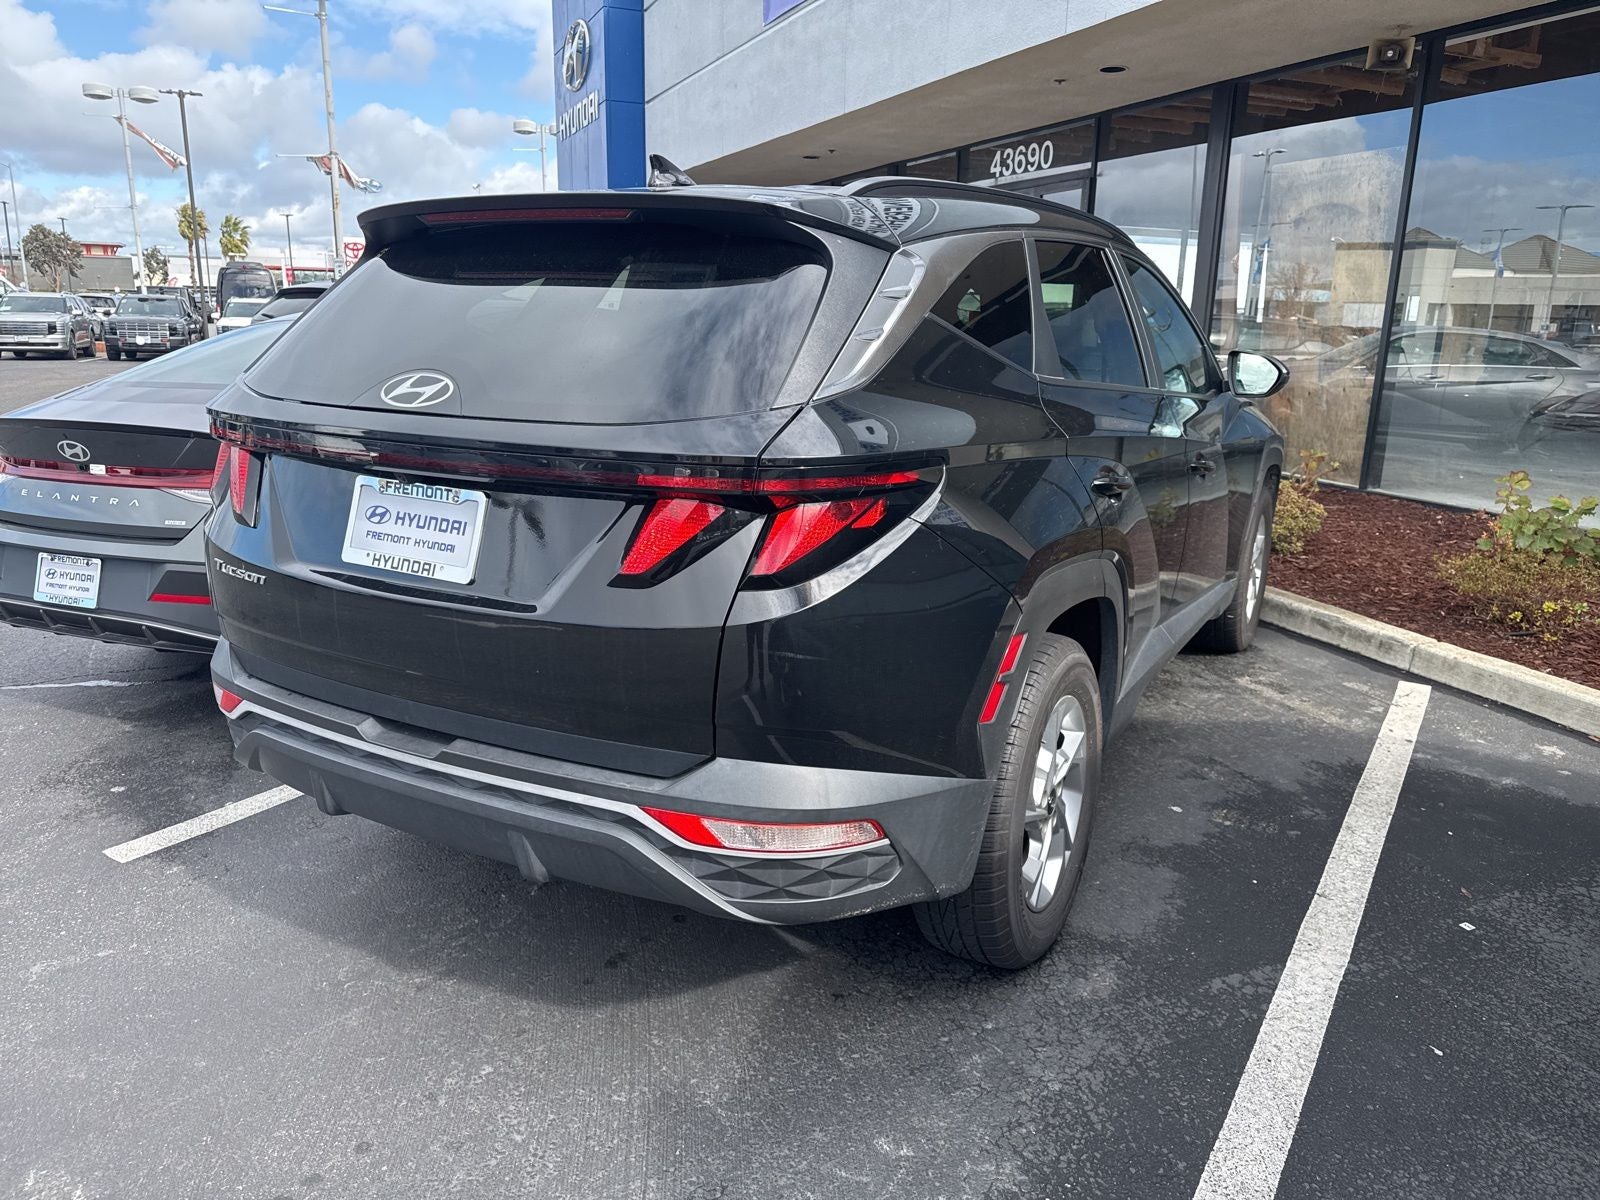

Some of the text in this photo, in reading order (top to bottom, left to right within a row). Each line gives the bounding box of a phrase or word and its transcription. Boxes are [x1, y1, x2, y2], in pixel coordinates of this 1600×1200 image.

[560, 90, 599, 141] HYUNDAI
[990, 140, 1053, 178] 43690
[21, 489, 140, 507] ELANTRA
[385, 480, 453, 501] FREMONT
[394, 511, 467, 536] HYUNDAI
[366, 530, 455, 553] FREMONT HYUNDAI
[53, 555, 85, 565] FREMONT
[371, 553, 437, 577] HYUNDAI
[59, 571, 95, 583] HYUNDAI
[49, 594, 80, 605] HYUNDAI
